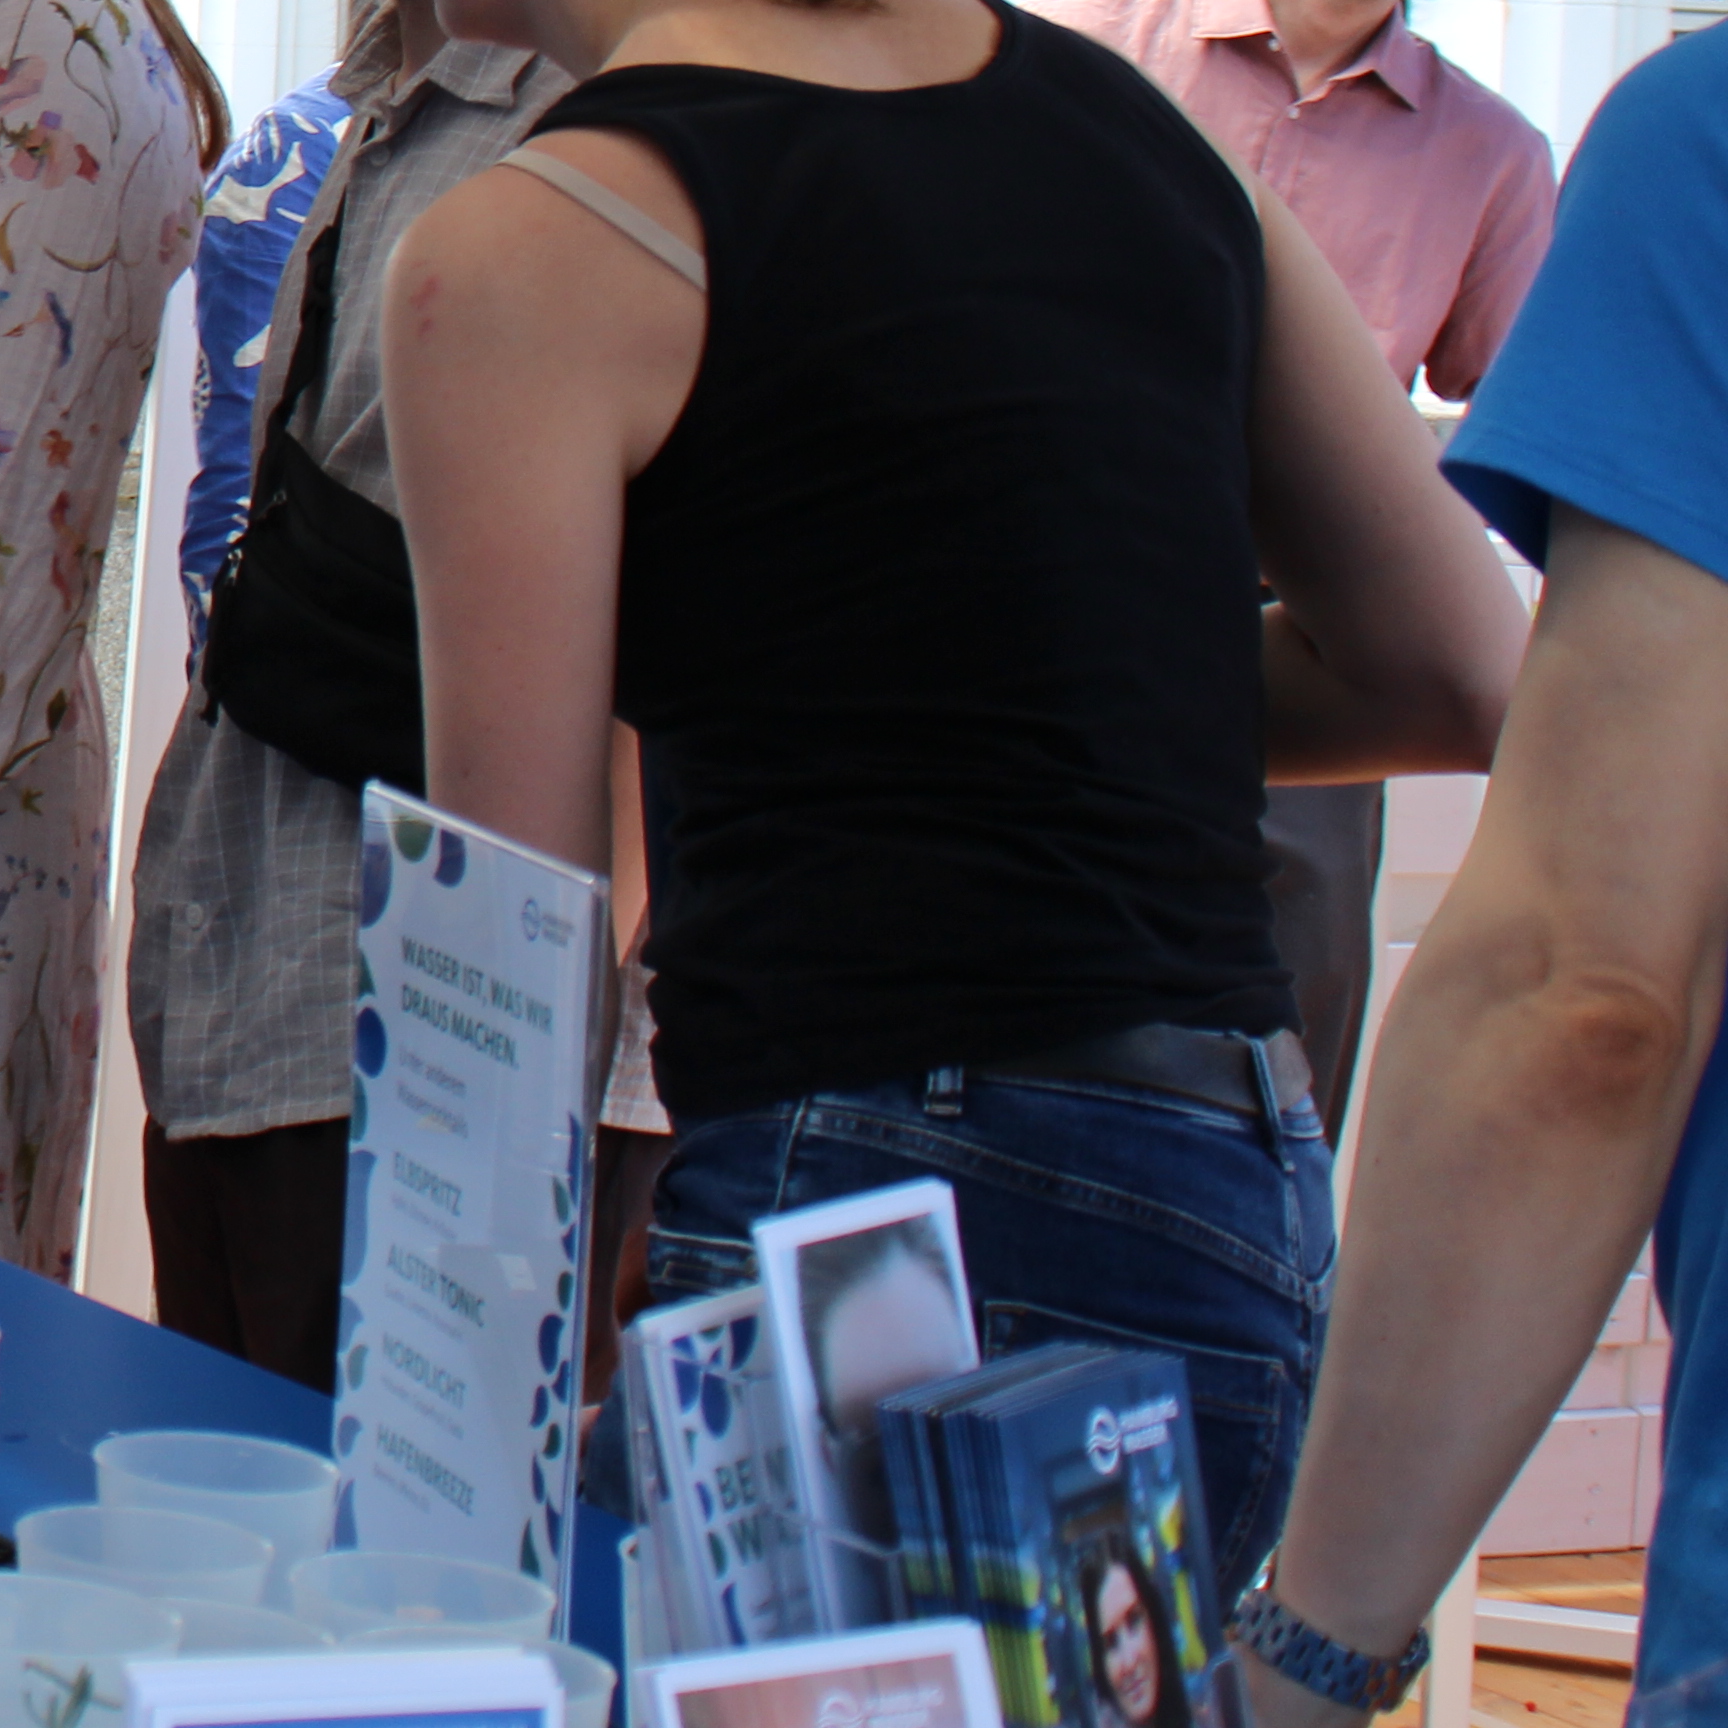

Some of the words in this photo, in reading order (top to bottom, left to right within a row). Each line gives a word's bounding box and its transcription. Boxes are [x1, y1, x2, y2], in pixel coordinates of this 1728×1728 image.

[401, 935, 461, 988] WASSER
[490, 976, 523, 1020] WAS
[401, 982, 449, 1033] DRAUS
[393, 1151, 462, 1217] ELBSPRITZ
[387, 1245, 437, 1295] ALSTER
[439, 1273, 485, 1329] TONIC
[382, 1331, 467, 1410] NORDLICHT
[376, 1424, 475, 1517] HAFENBREEZE
